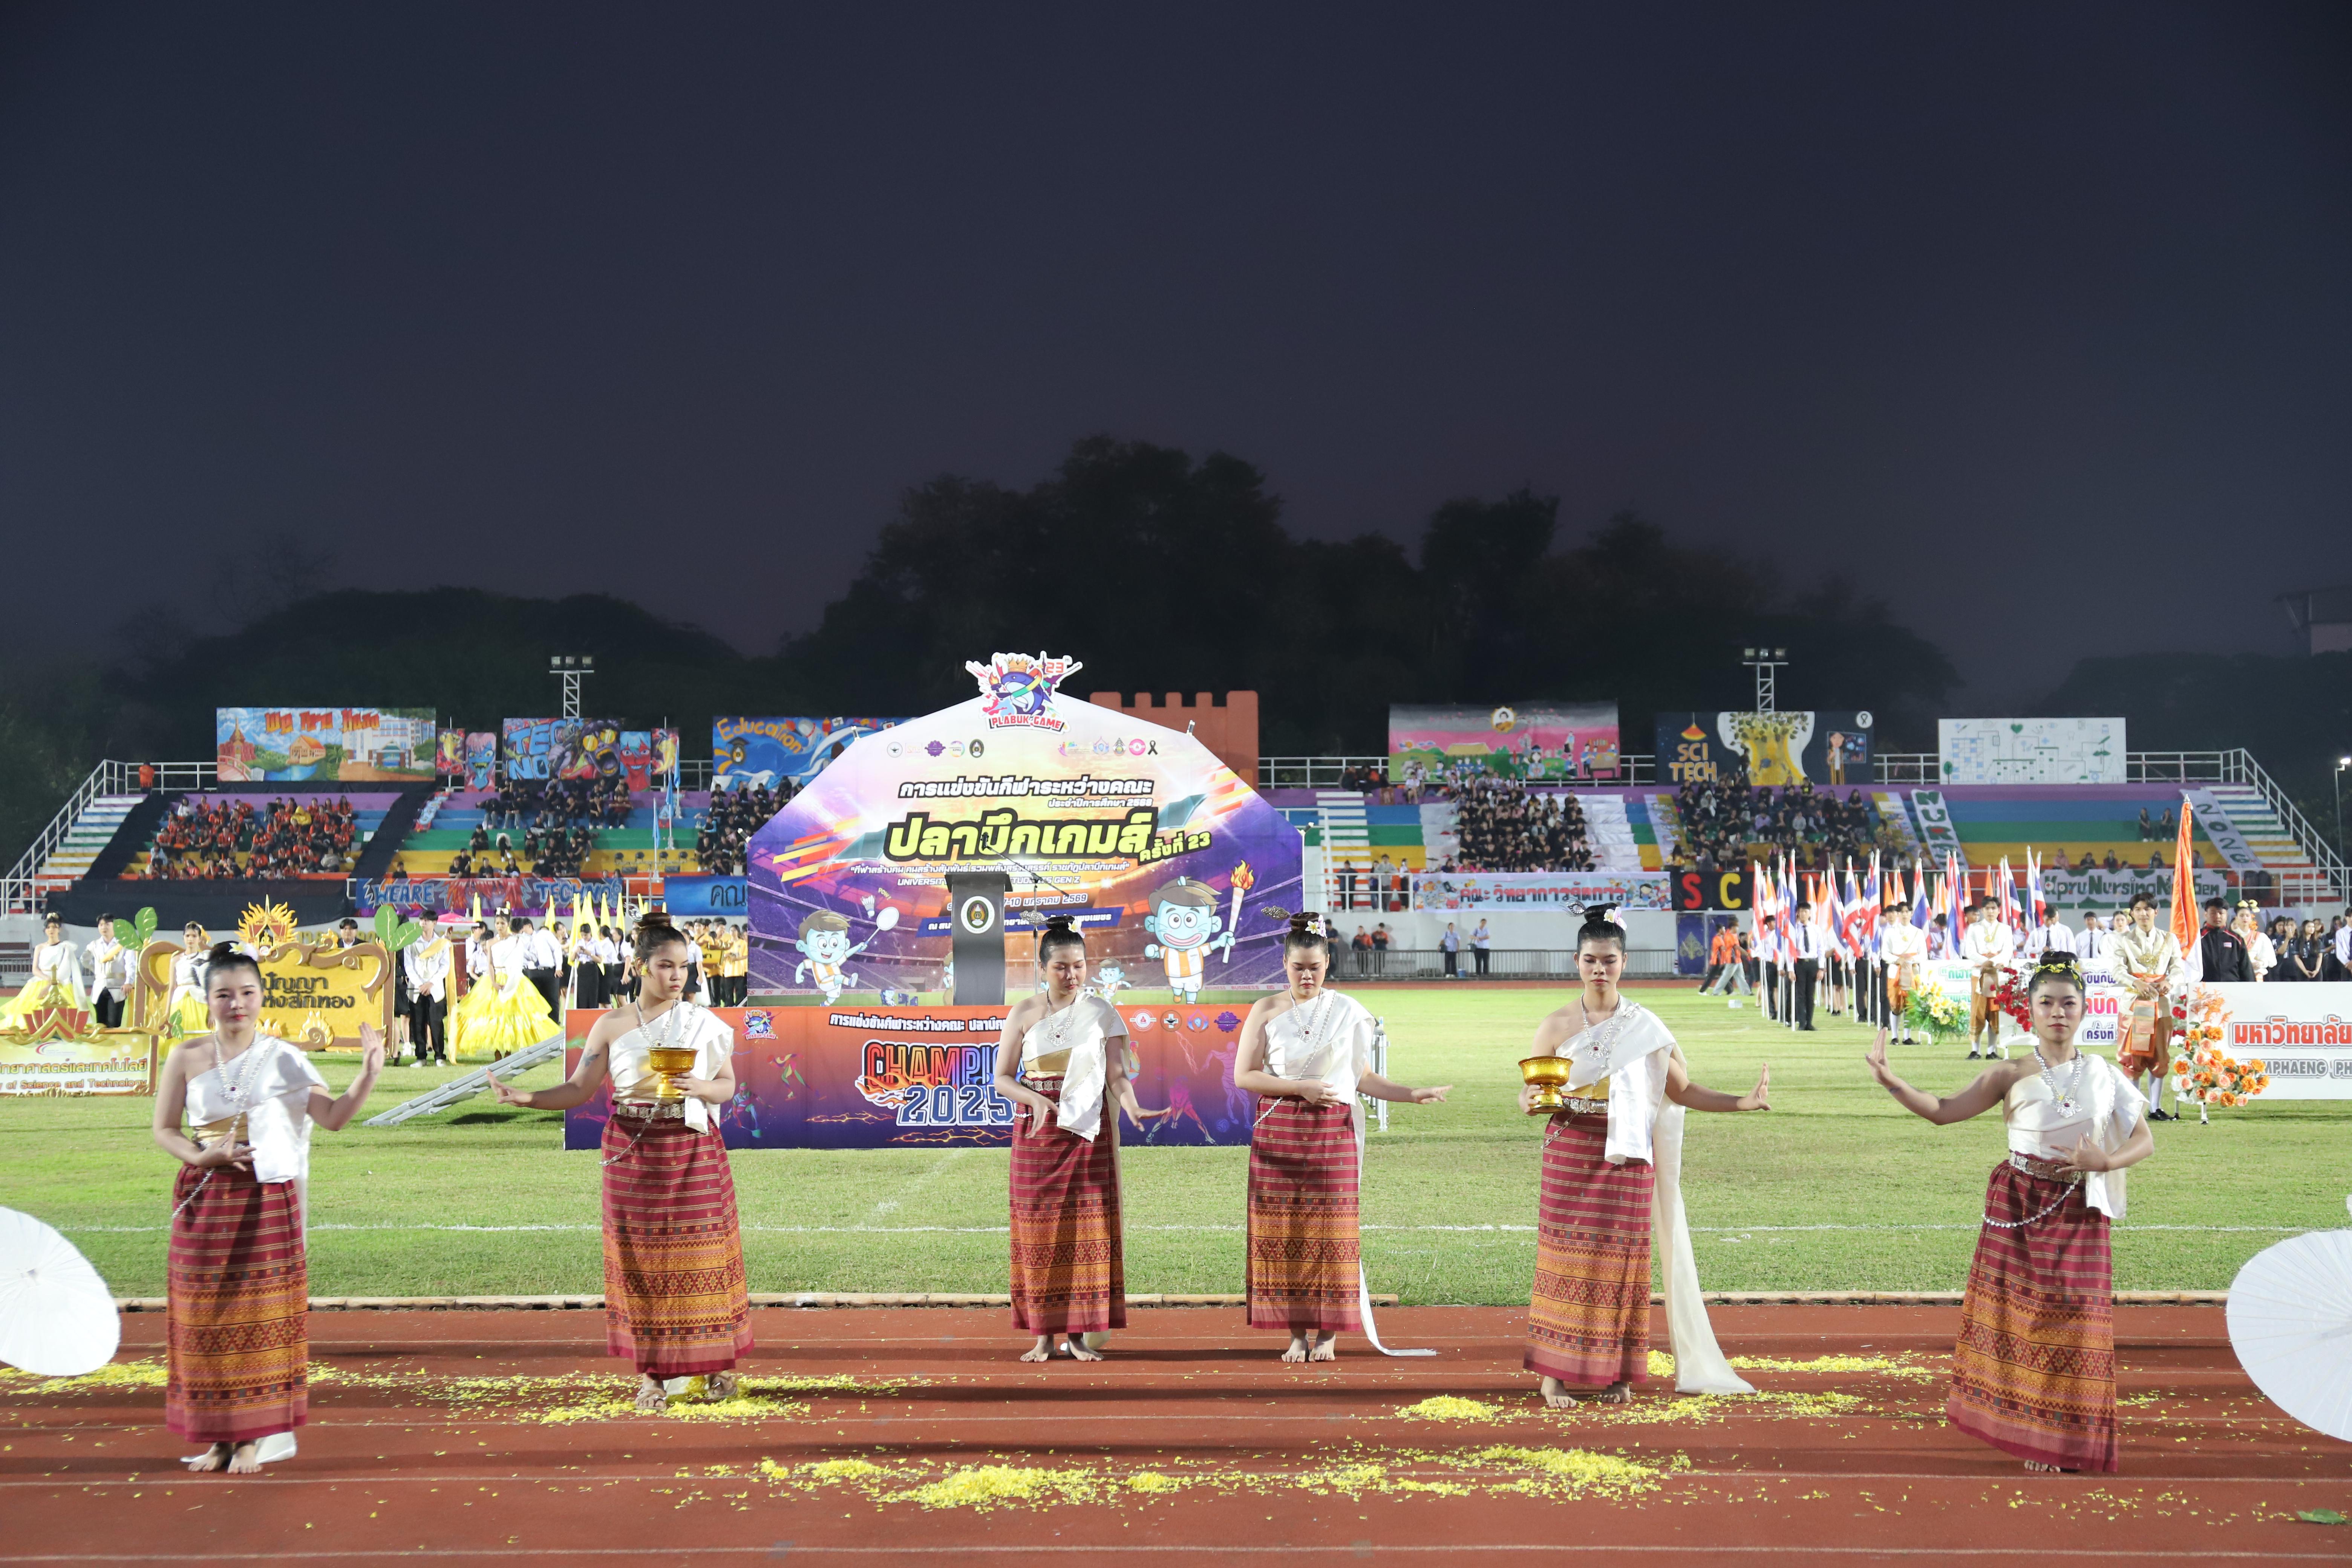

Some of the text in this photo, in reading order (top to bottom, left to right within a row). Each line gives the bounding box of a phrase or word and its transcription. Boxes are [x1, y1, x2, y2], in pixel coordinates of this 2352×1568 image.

[992, 715, 1062, 729] PLABUK GAME
[717, 717, 804, 754] Education
[1677, 743, 1709, 762] SCI
[1669, 761, 1717, 782] TECH
[900, 777, 1153, 797] การแข่งขันกีฬาระหว่างคณะ
[1049, 798, 1153, 807] ประจำปีการศึกษา 2568
[890, 812, 1152, 858] ปลาบึกเกมส์
[1139, 832, 1211, 862] ครั้งที่ 23
[877, 887, 892, 900] POW!
[1063, 894, 1087, 903] 2569
[1460, 888, 1490, 902] คณะ
[830, 1013, 1004, 1031] การแข่งขันกีฬาระหว่างคณะ ปลาบึก
[2234, 1017, 2352, 1044] มหาวิทยาลัย
[0, 1058, 148, 1074] ทยาศาสตร์และเทคโนโลยี
[6, 1080, 17, 1089] of
[66, 1079, 84, 1088] and
[900, 1086, 1014, 1124] 2025
